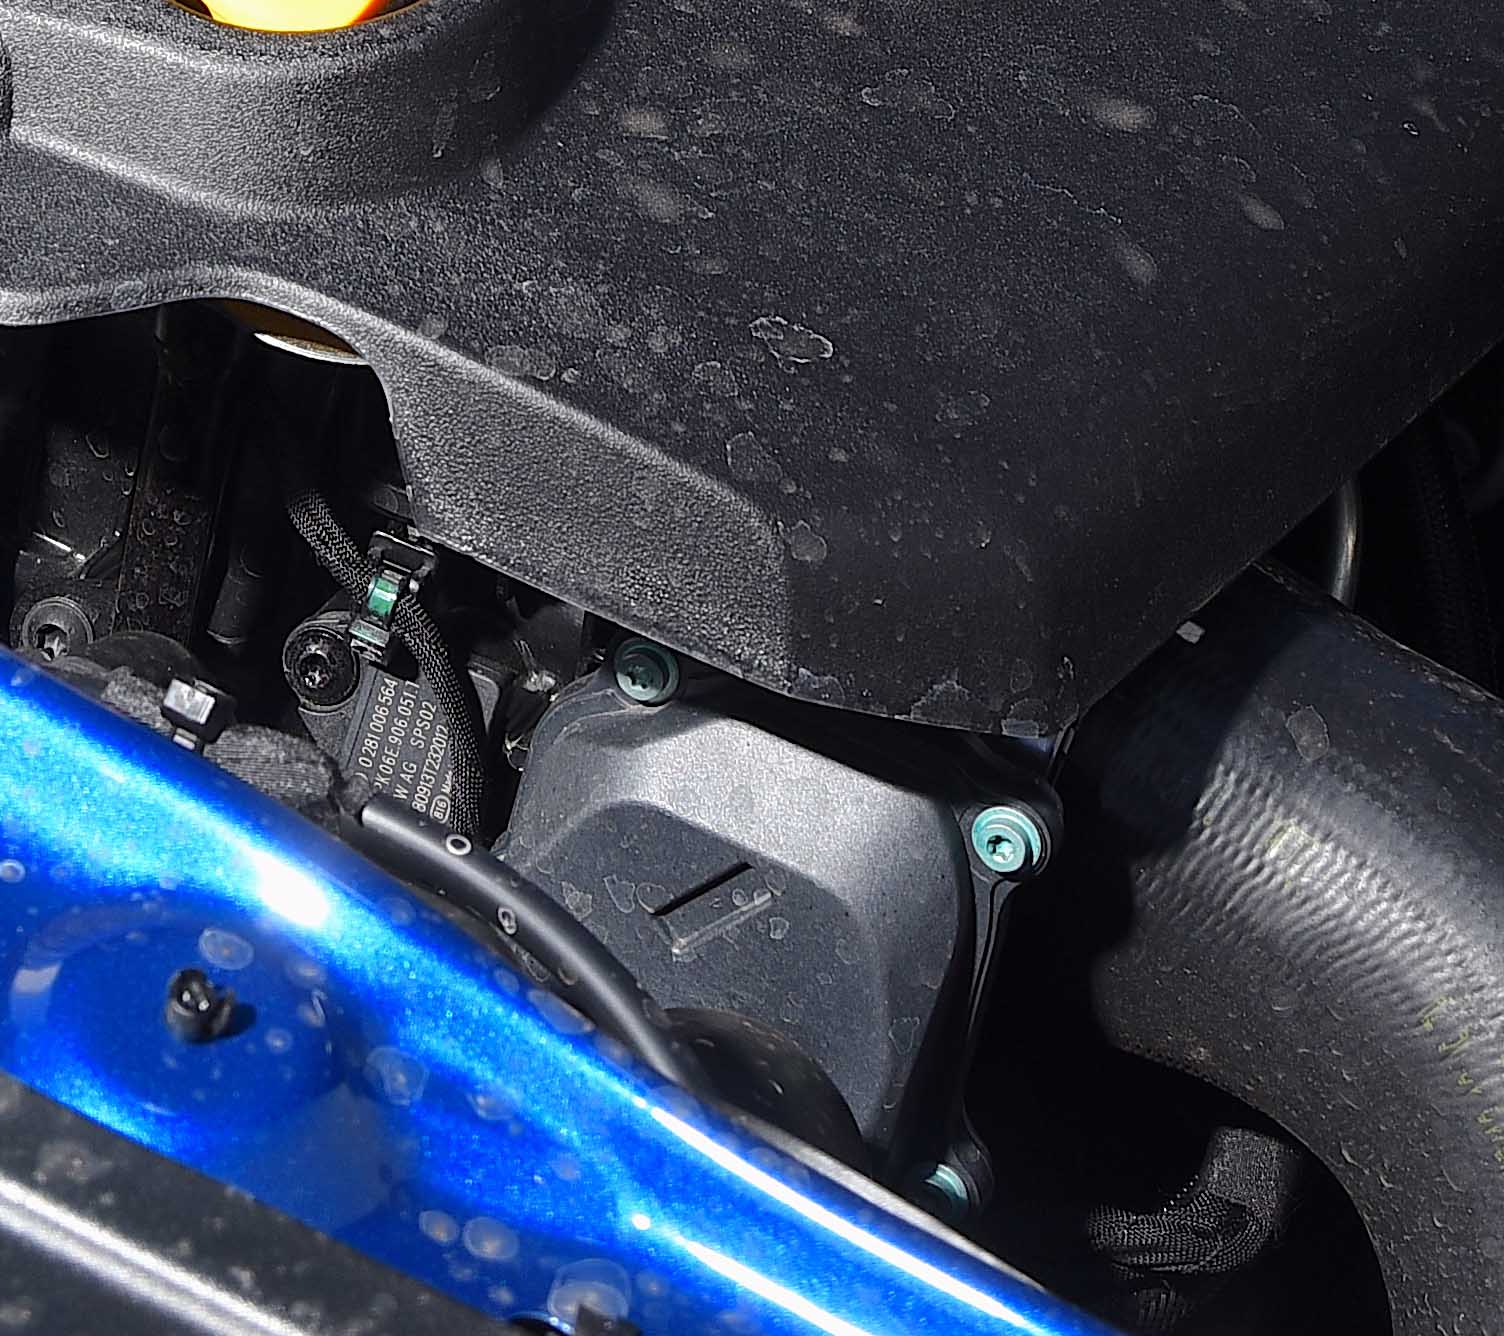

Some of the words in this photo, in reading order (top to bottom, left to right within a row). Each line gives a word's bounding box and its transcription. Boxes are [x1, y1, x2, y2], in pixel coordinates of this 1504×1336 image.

[378, 677, 399, 706] 564
[369, 703, 390, 734] 006
[362, 733, 380, 758] 281
[400, 761, 417, 784] AG
[410, 700, 437, 749] SPS02
[358, 756, 373, 768] 0
